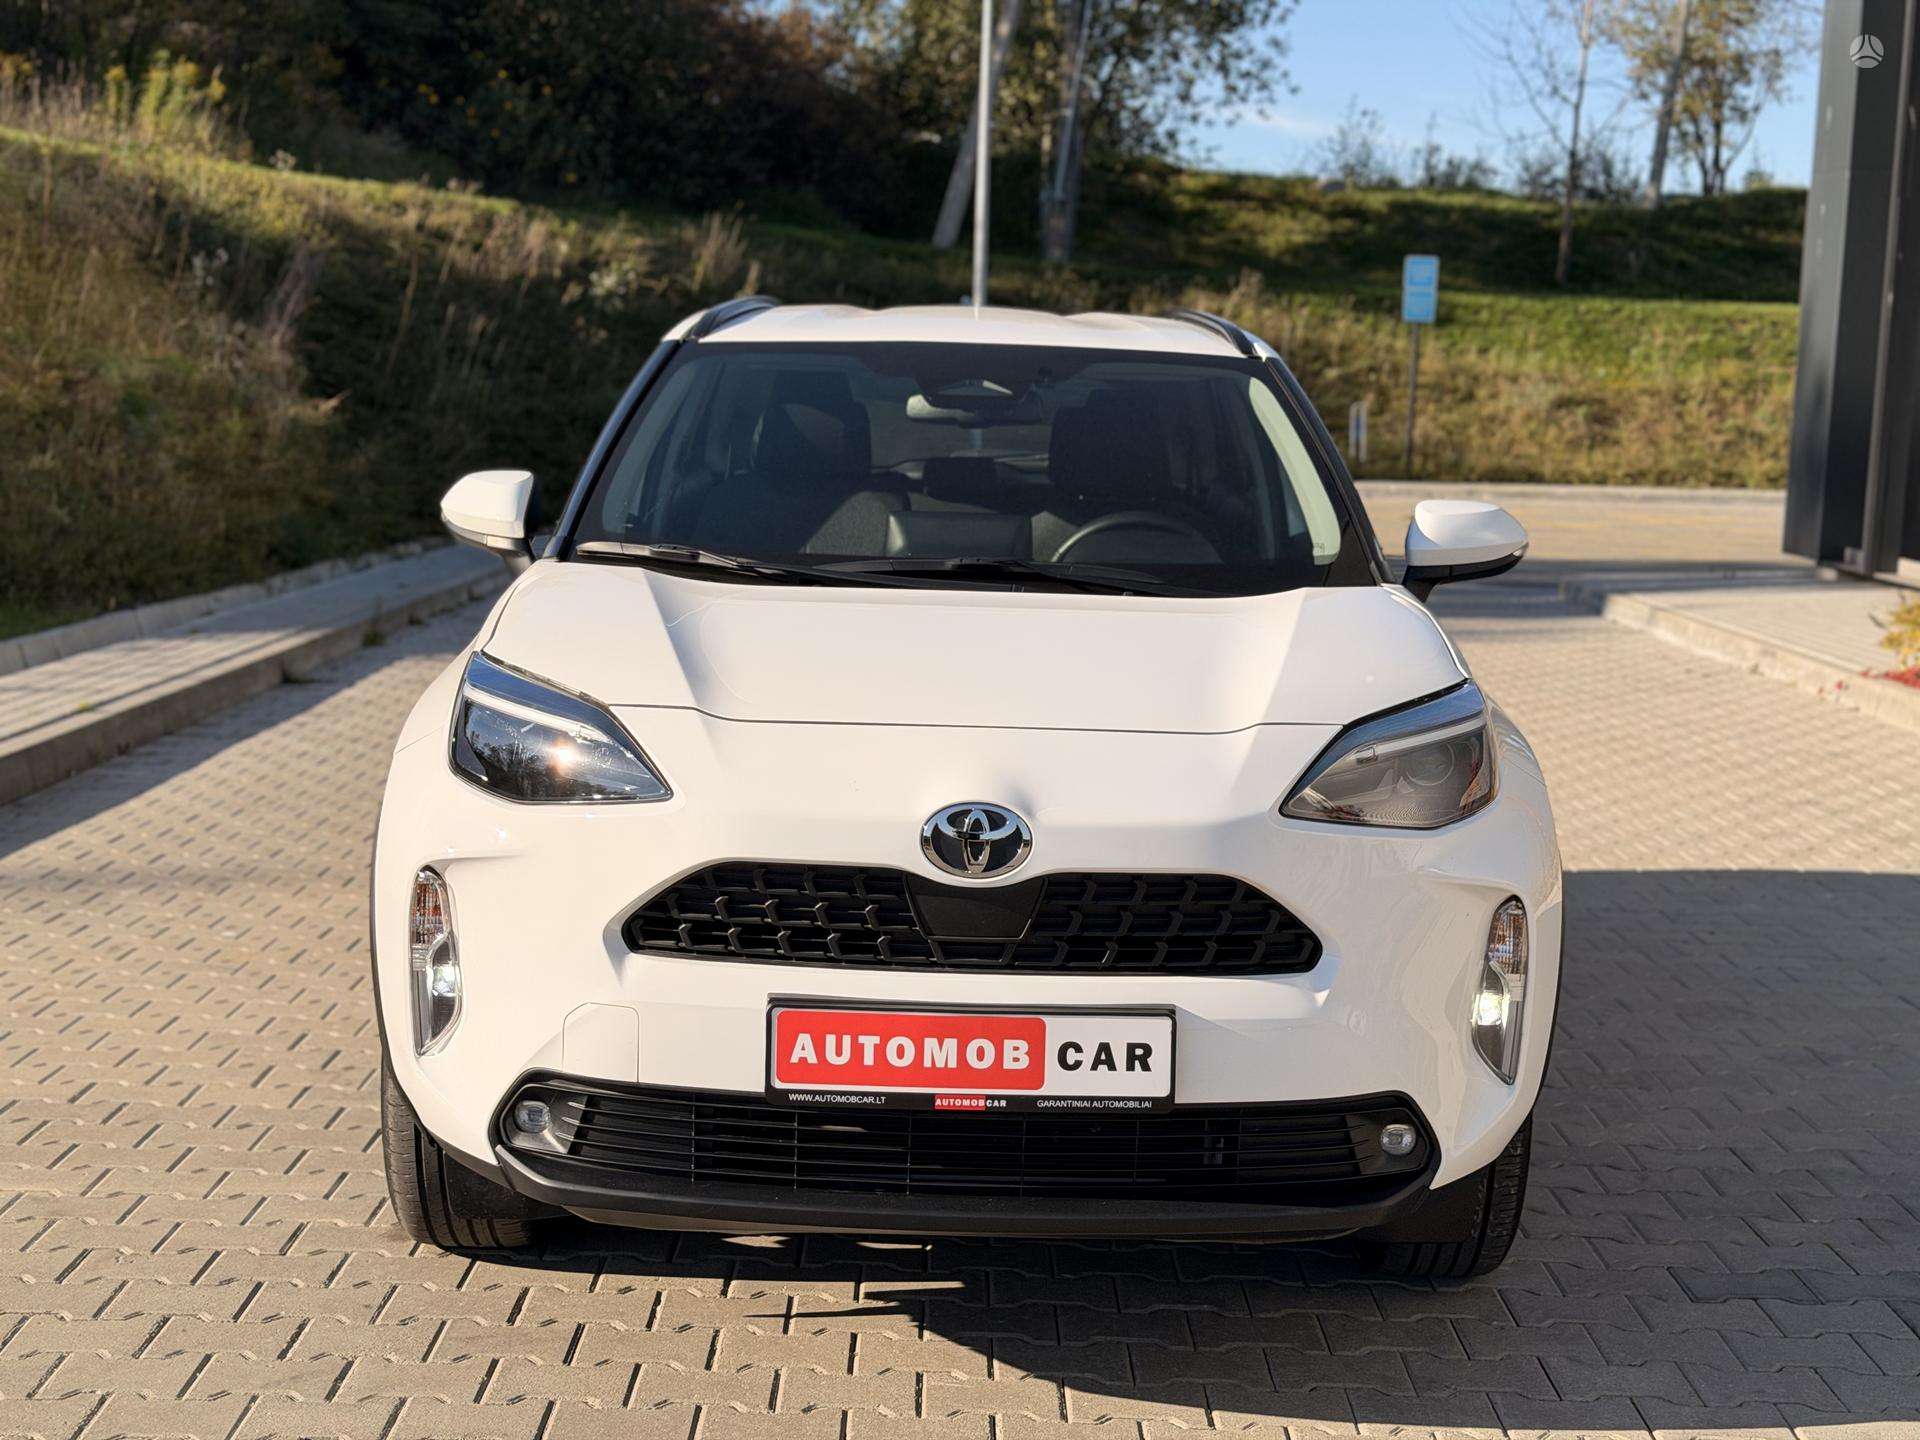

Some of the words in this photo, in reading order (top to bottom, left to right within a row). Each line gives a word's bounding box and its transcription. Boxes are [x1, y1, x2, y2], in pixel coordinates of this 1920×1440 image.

[789, 1033, 1030, 1070] AUTOMOB
[1057, 1040, 1153, 1073] CAR
[788, 1093, 886, 1104] WWW.AUTOMOBCAR.LT
[1037, 1100, 1091, 1108] GARANTINIAI
[1092, 1100, 1152, 1108] AUTOMOBILIAI
